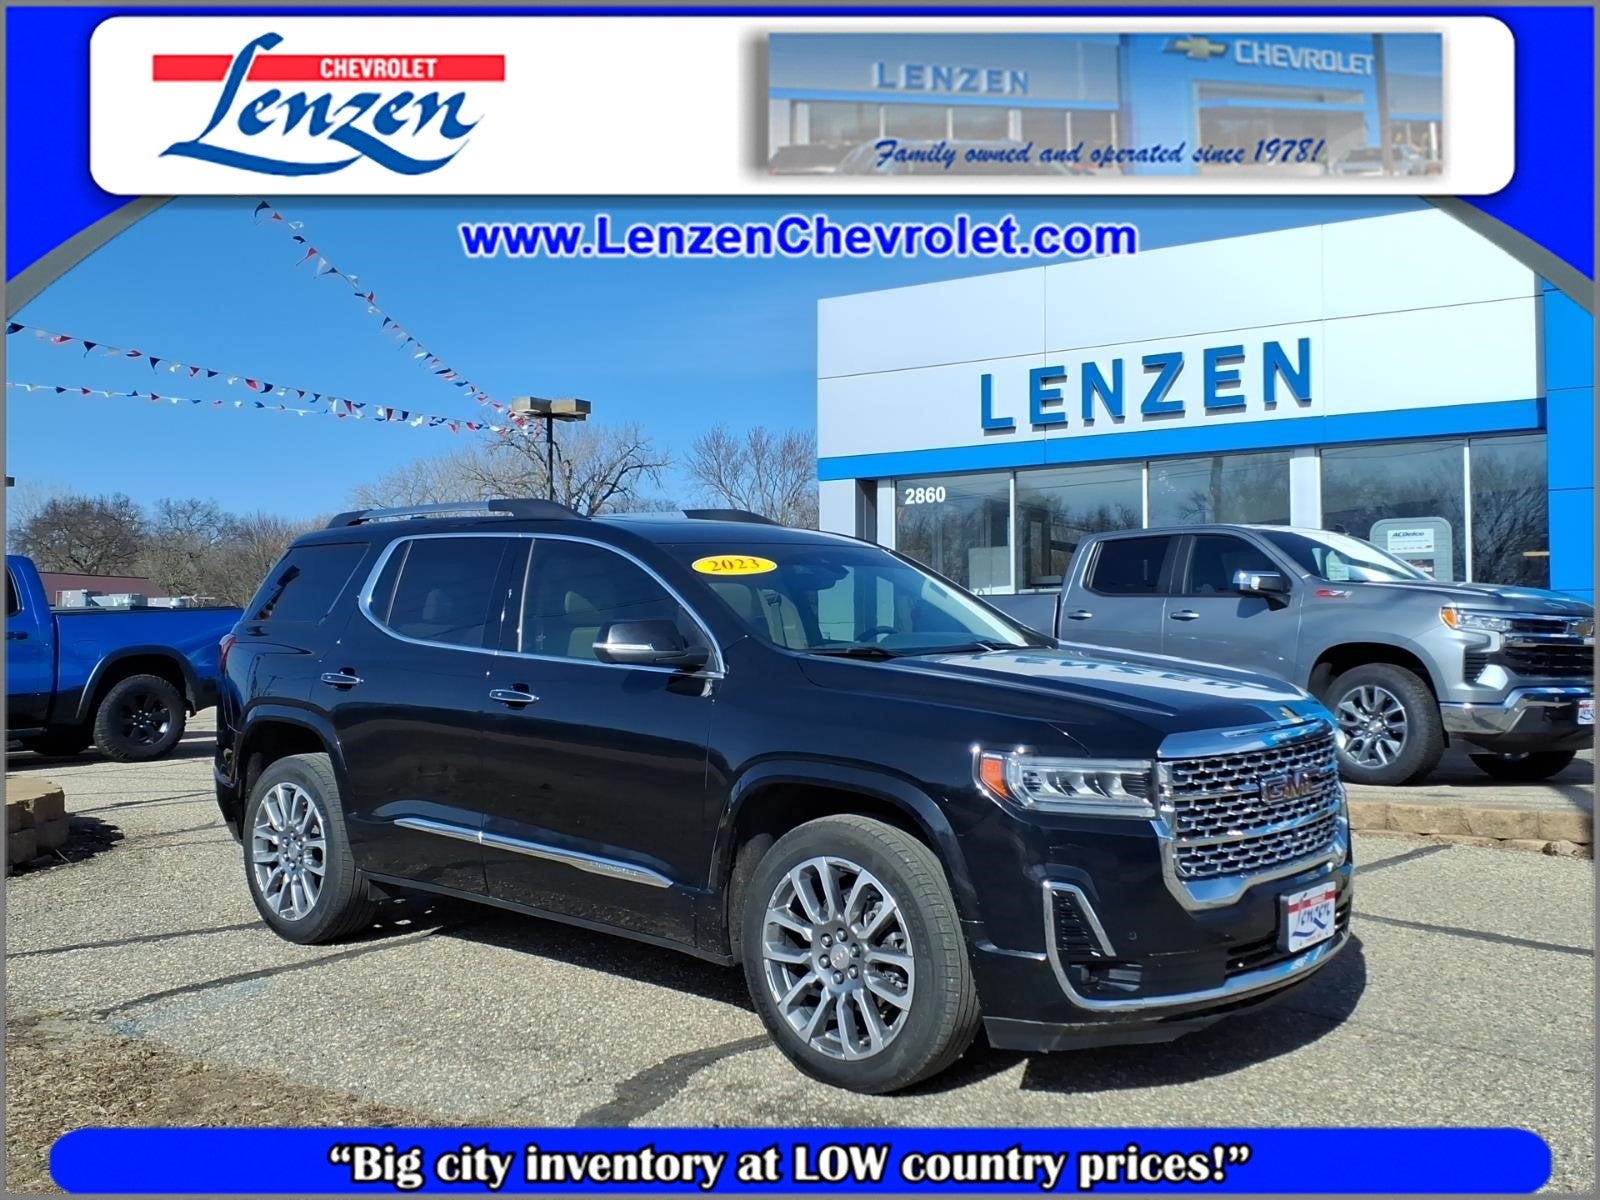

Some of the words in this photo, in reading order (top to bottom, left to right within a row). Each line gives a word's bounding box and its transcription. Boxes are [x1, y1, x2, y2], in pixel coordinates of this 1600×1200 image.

[980, 337, 1312, 433] LENZEN
[905, 486, 946, 504] 2860
[708, 558, 760, 571] 2023
